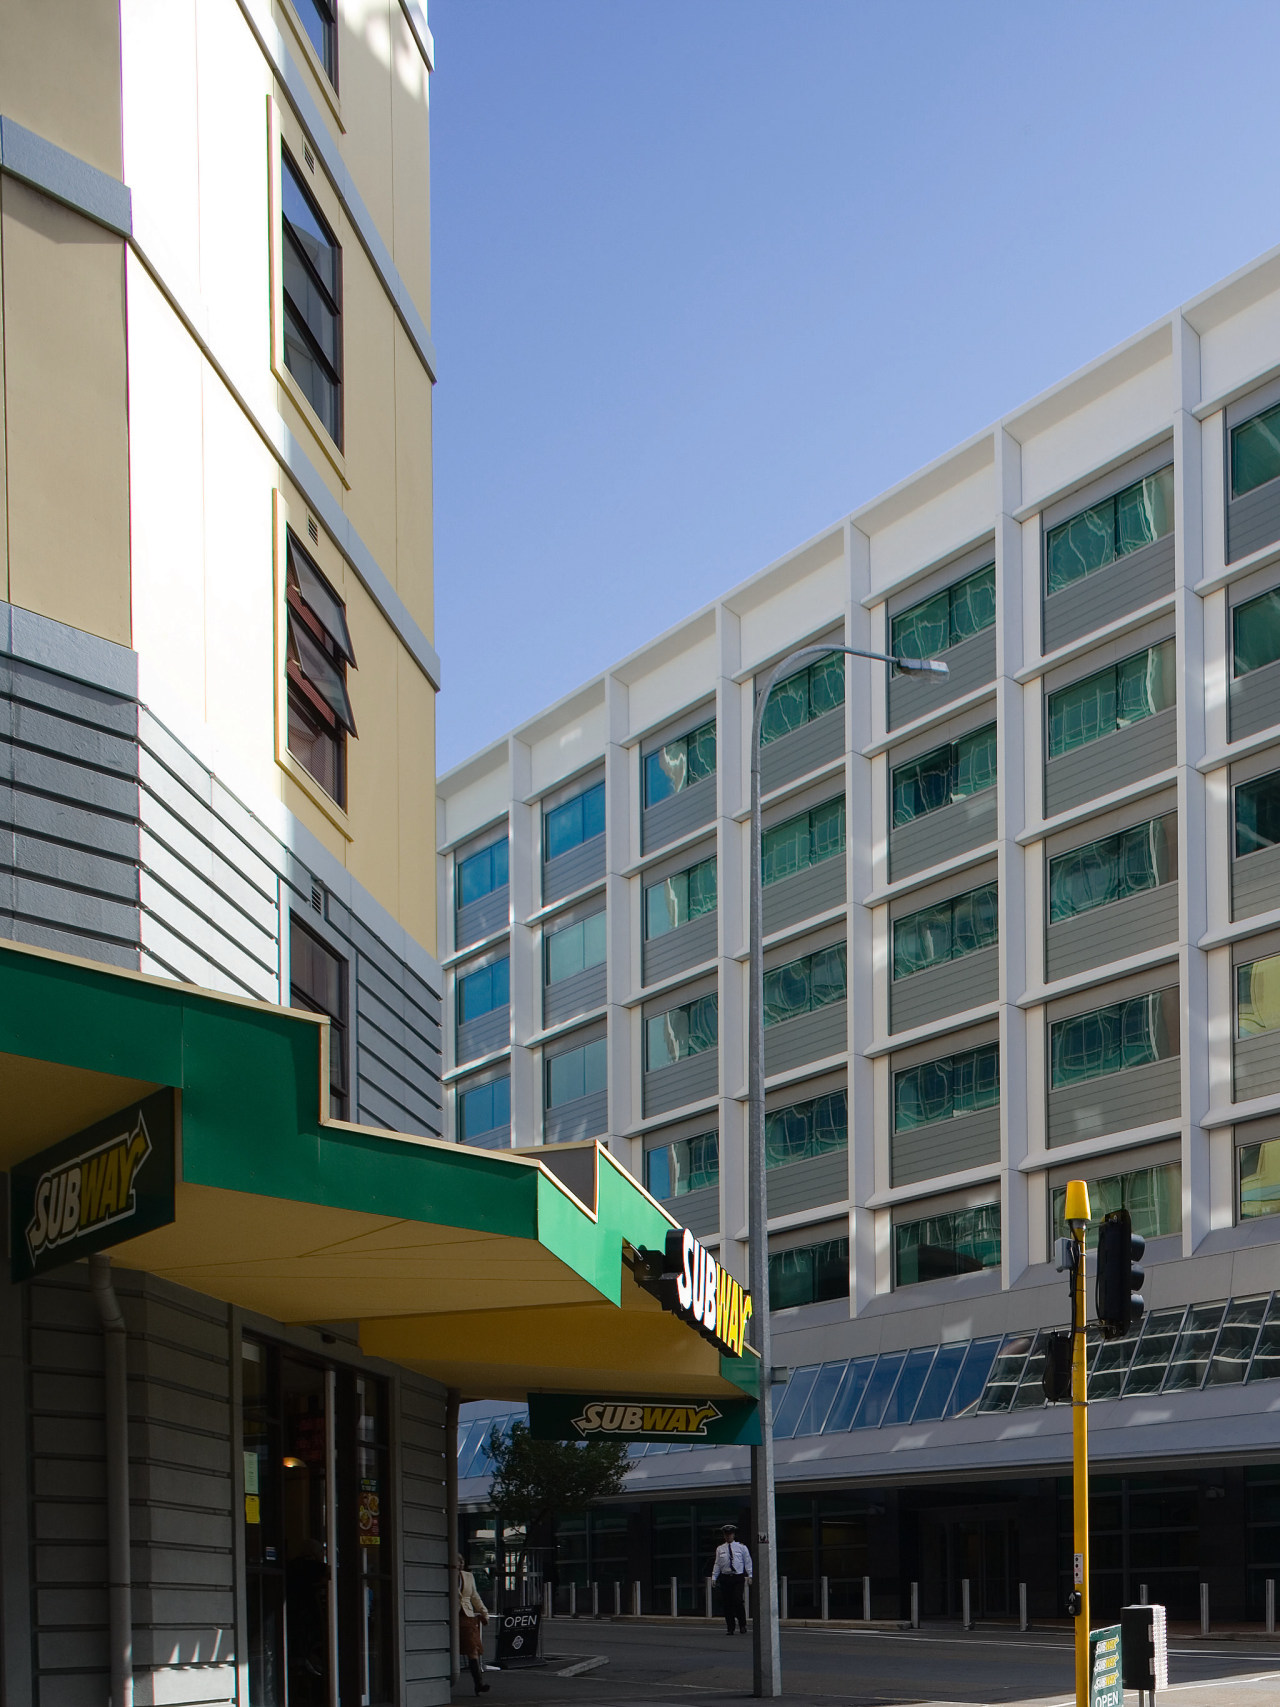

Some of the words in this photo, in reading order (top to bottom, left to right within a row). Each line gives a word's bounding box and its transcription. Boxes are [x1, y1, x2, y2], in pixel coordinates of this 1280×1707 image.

[28, 1129, 151, 1248] SUBWAY
[677, 1228, 753, 1358] SUBWAY
[575, 1403, 719, 1433] SUBWAY
[504, 1615, 538, 1628] OPEN
[1095, 1637, 1119, 1655] SUBWAY
[1094, 1655, 1119, 1674] SUBWAY
[1094, 1673, 1119, 1692] SUBWAY
[1095, 1691, 1119, 1707] OPEN
